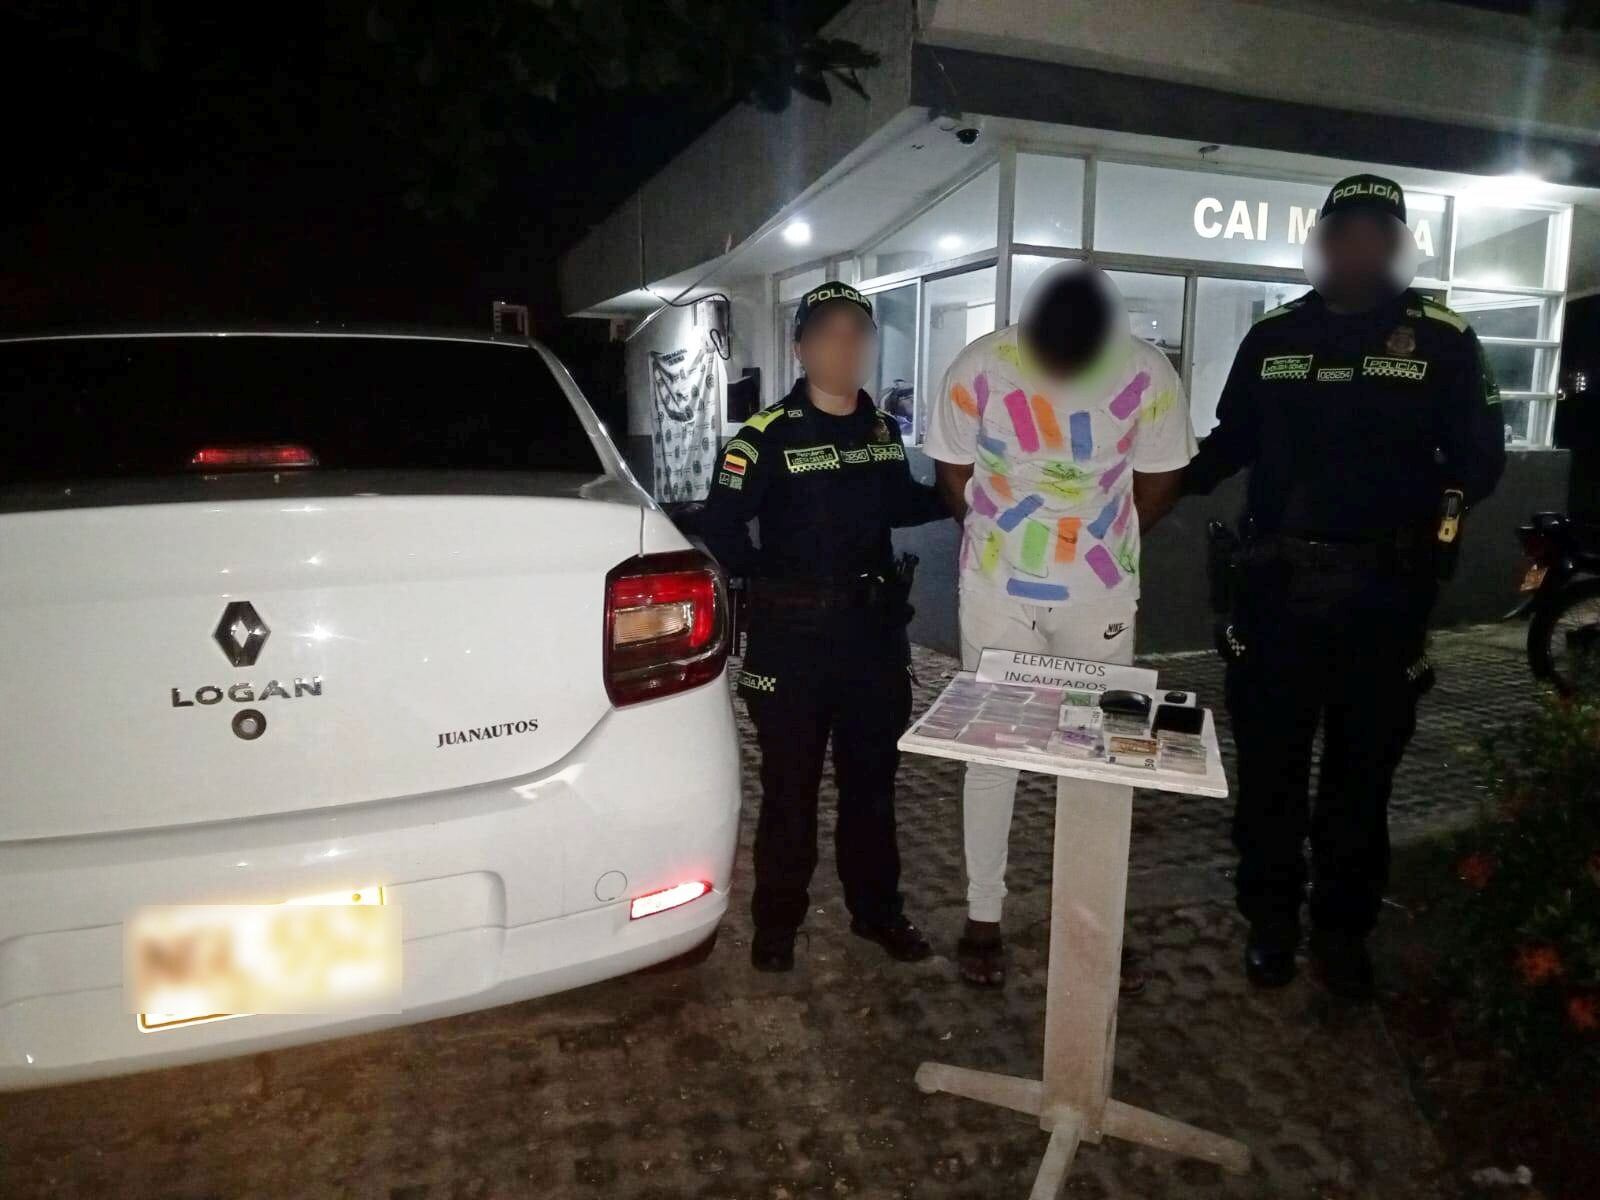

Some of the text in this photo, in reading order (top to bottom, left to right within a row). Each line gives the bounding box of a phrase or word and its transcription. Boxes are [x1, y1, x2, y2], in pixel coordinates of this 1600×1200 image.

[1193, 197, 1269, 241] CAI
[1013, 653, 1106, 677] ELEMENTOS
[171, 676, 322, 708] LOGAN
[1004, 671, 1108, 691] INCAUTADOS
[436, 718, 539, 748] JUANAUTOS
